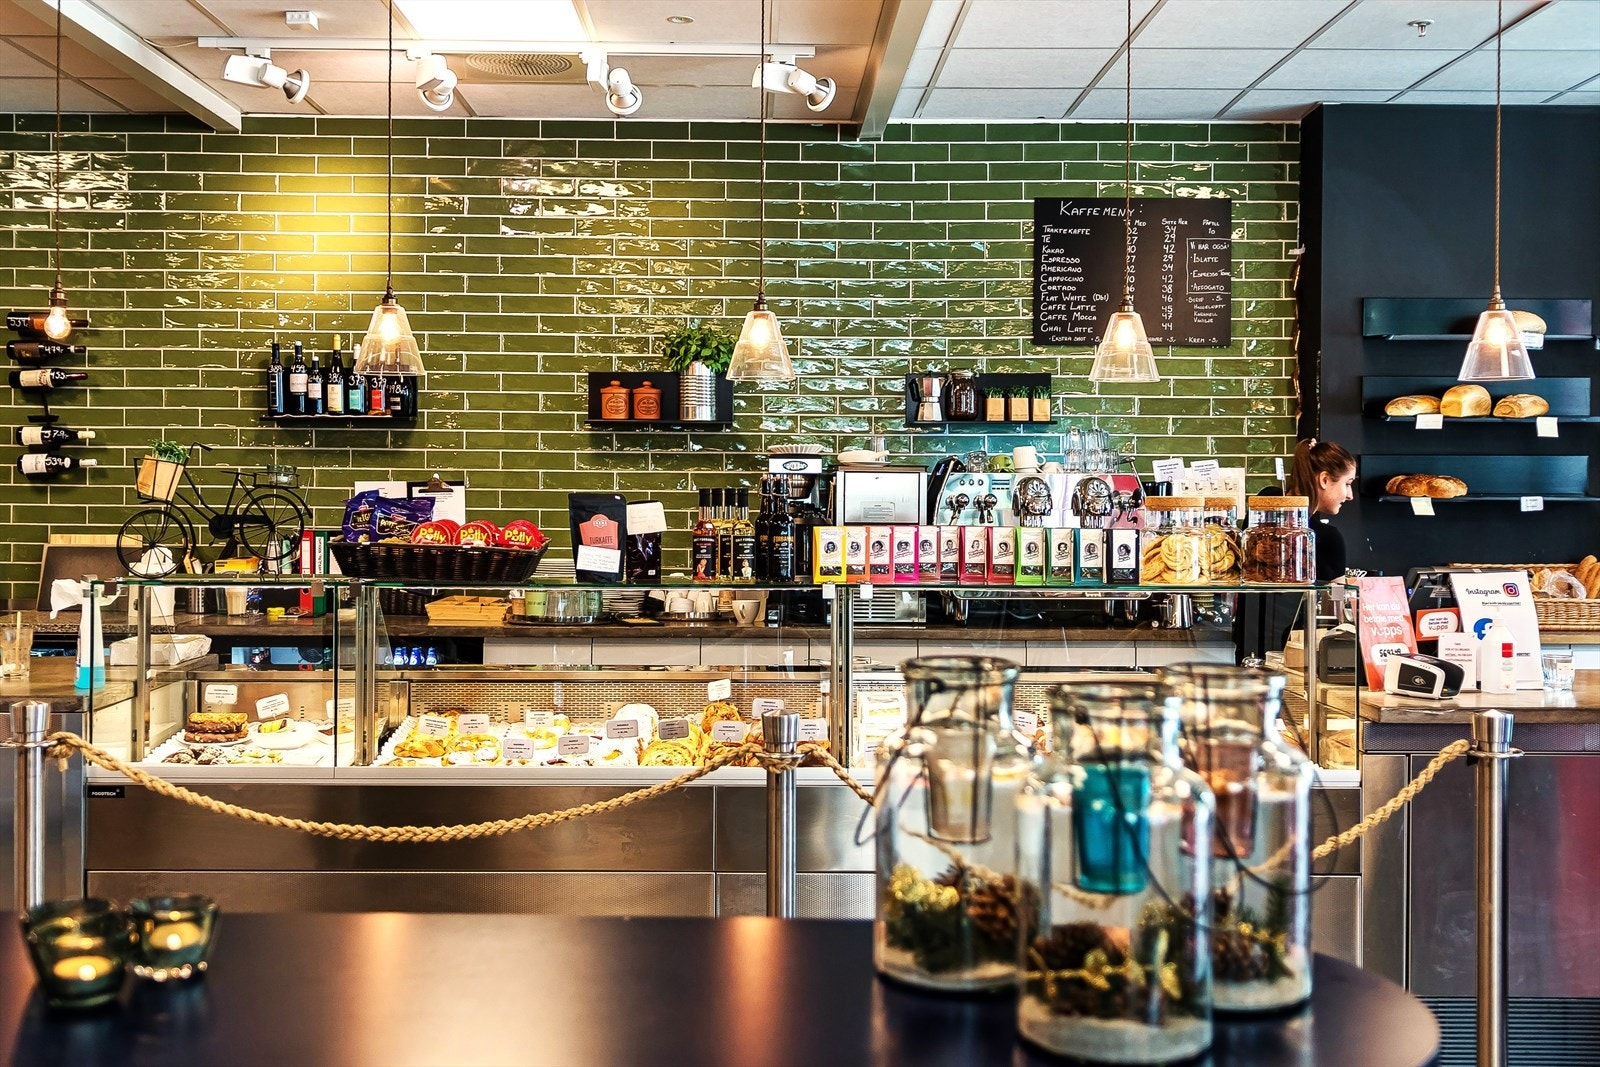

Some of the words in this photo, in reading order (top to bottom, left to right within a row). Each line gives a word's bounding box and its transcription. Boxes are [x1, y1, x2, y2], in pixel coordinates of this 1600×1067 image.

[1164, 226, 1176, 234] 34
[1164, 234, 1176, 242] 29
[1163, 244, 1176, 253] 42
[1162, 274, 1174, 283] 42
[1162, 285, 1173, 293] 38
[1041, 292, 1058, 301] FLAT
[1062, 292, 1086, 301] WHITE
[1040, 302, 1066, 311] CAFFE
[1070, 302, 1096, 311] LATTE
[1040, 312, 1067, 321] CAFFE
[1068, 322, 1093, 333] LATTE
[504, 528, 532, 545] Polly
